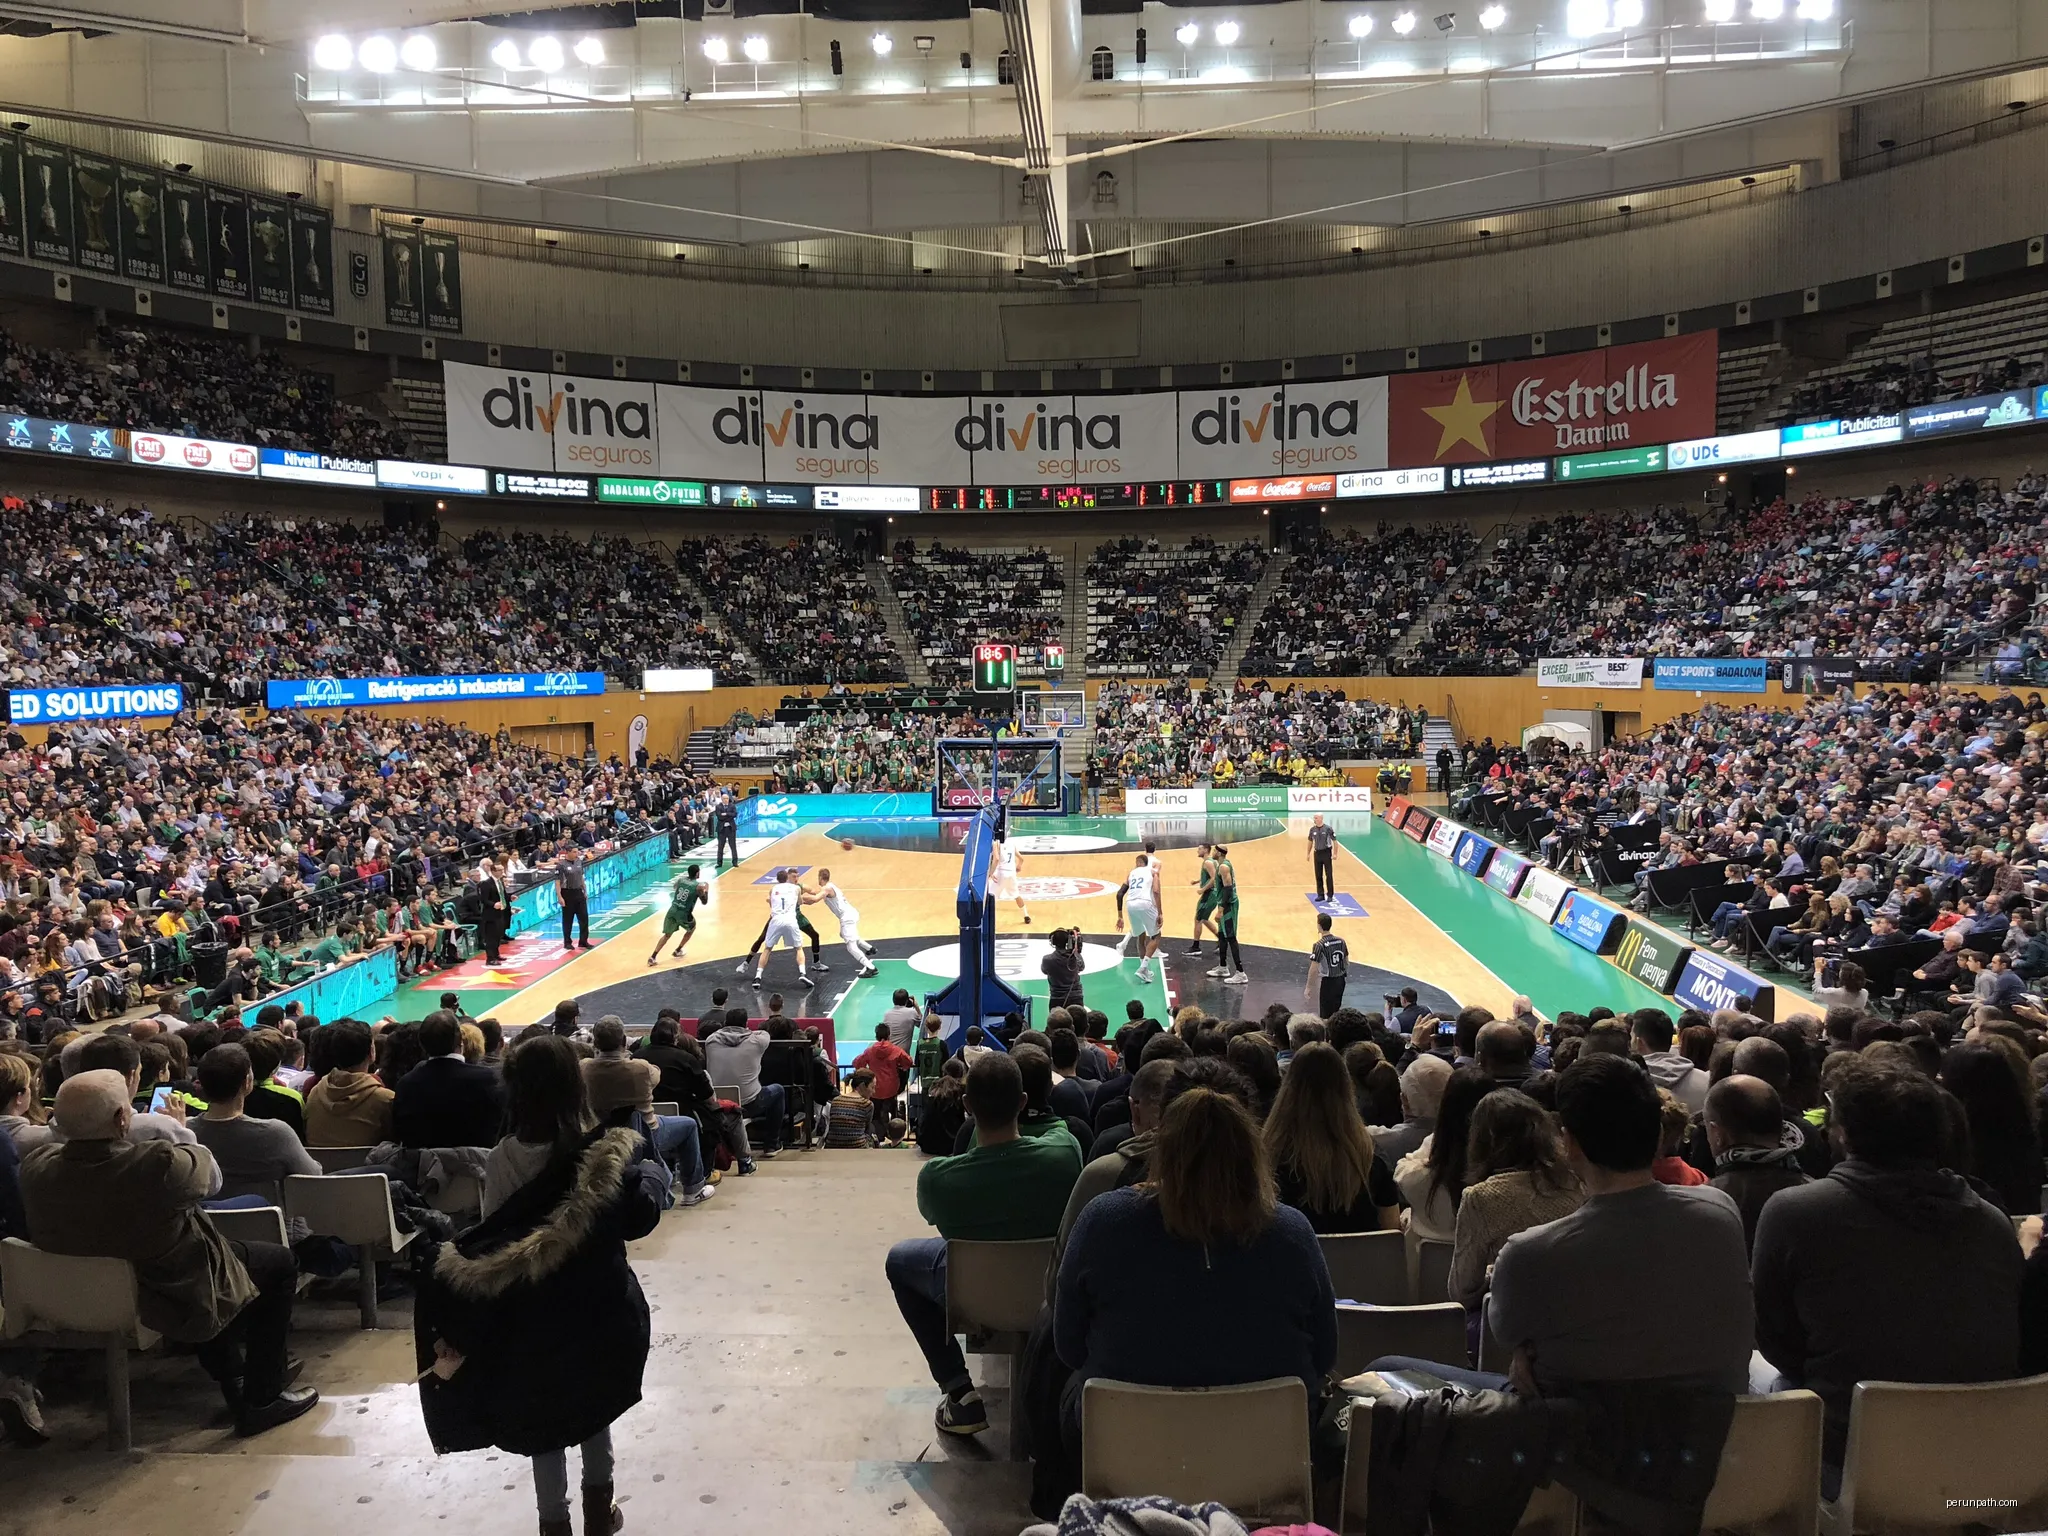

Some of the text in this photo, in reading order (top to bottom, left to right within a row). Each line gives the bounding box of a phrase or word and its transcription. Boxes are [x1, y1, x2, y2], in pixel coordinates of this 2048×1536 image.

[354, 255, 367, 295] CJB
[1512, 362, 1679, 426] Estrella
[482, 377, 651, 440] divina
[1192, 392, 1358, 445] divina
[712, 396, 880, 450] divina
[955, 403, 1121, 451] divina
[1840, 413, 1900, 434] Publicitari
[1555, 422, 1631, 449] Damm
[284, 452, 374, 473] Nivell Publicitari
[568, 444, 652, 469] seguros
[1272, 444, 1358, 468] seguros
[1692, 444, 1720, 460] UDE
[796, 455, 879, 478] seguros
[1037, 458, 1121, 479] seguros
[603, 484, 701, 499] BADALONA FUTUR
[980, 647, 1003, 660] 18:6
[986, 660, 1009, 684] 11
[1542, 663, 1569, 676] EXCEED
[1571, 671, 1595, 683] LIMITS
[1608, 663, 1627, 671] BEST
[1657, 665, 1763, 678] DUET SPORTS BADALONA
[368, 677, 525, 701] Refrigeració industrial
[46, 688, 179, 717] SOLUTIONS
[1144, 793, 1188, 805] divina
[1130, 877, 1144, 889] 22
[780, 897, 785, 910] 1
[1638, 937, 1658, 960] Fem
[1640, 962, 1668, 988] penya
